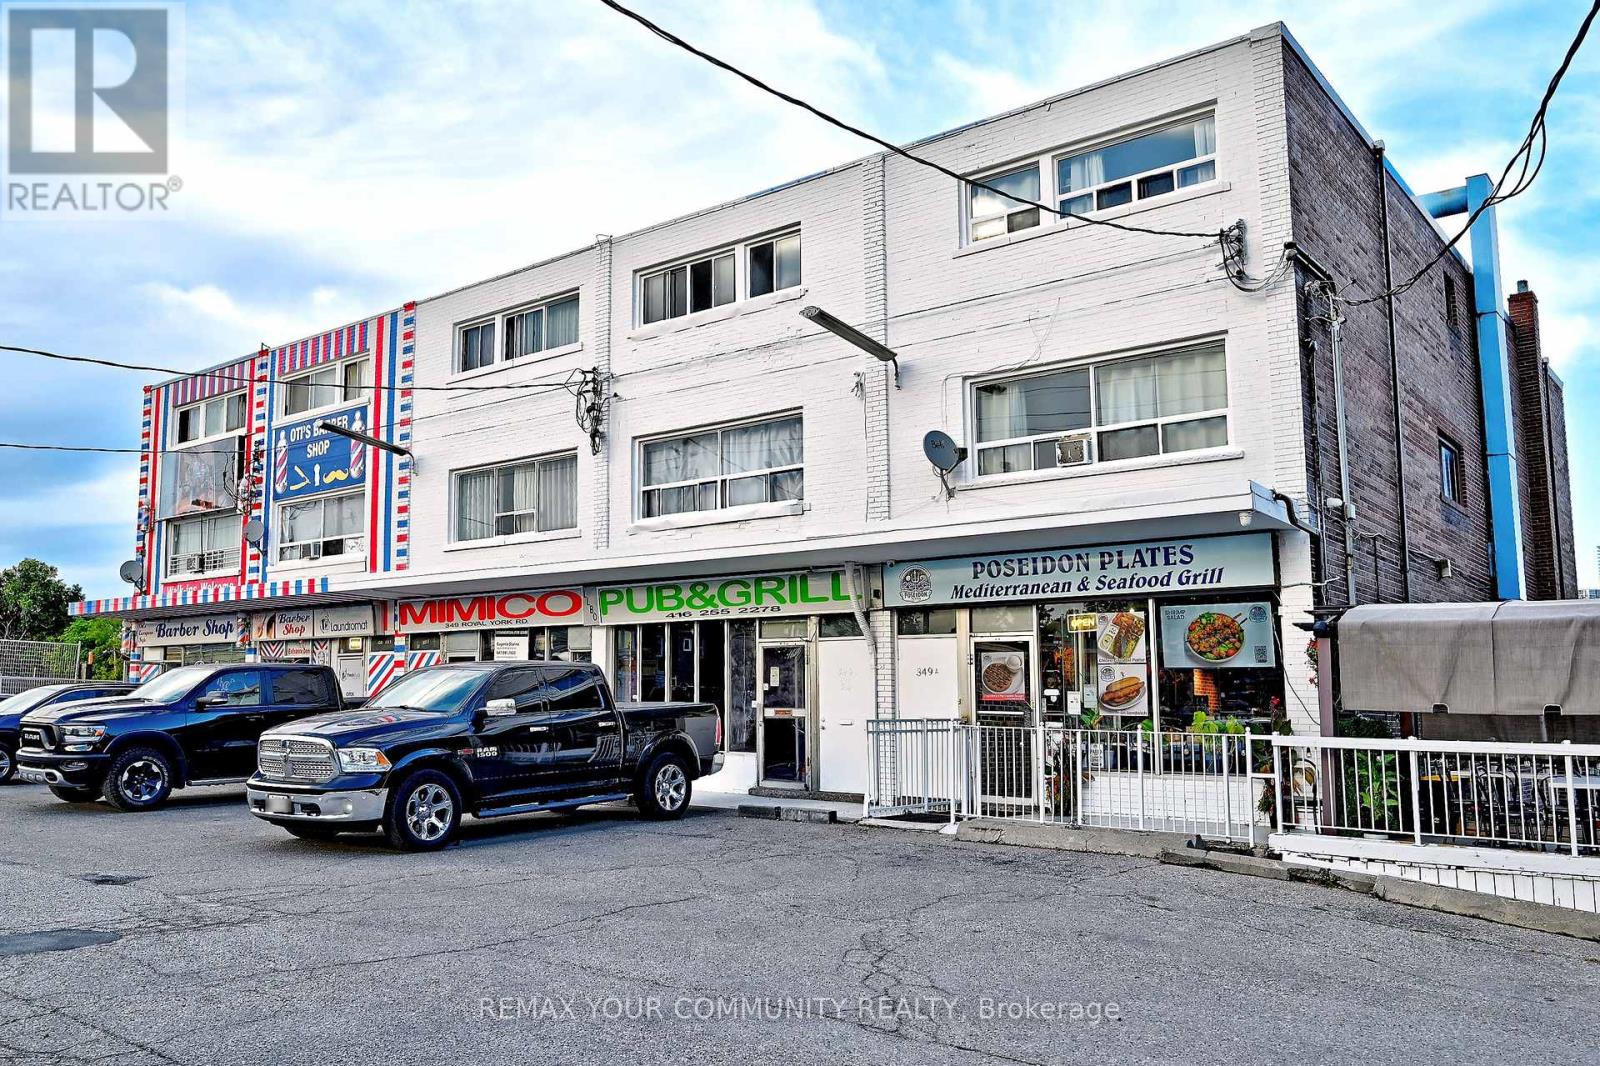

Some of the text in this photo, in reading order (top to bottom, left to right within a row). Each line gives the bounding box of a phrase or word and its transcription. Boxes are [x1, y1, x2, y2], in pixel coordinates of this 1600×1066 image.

[290, 424, 312, 442] OTI'S
[306, 440, 330, 458] SHOP
[972, 544, 1194, 580] POSEIDON PLATES
[950, 567, 1225, 600] Mediterranean & Seafood Grill
[600, 572, 863, 616] PUB&GRILL
[400, 590, 583, 625] MIMICO
[665, 605, 782, 619] 416 255 2278
[279, 610, 310, 624] Barber
[330, 620, 368, 632] Laundromat
[1071, 617, 1095, 630] OPEN
[155, 619, 235, 639] Barber Shop
[282, 624, 306, 636] Shop
